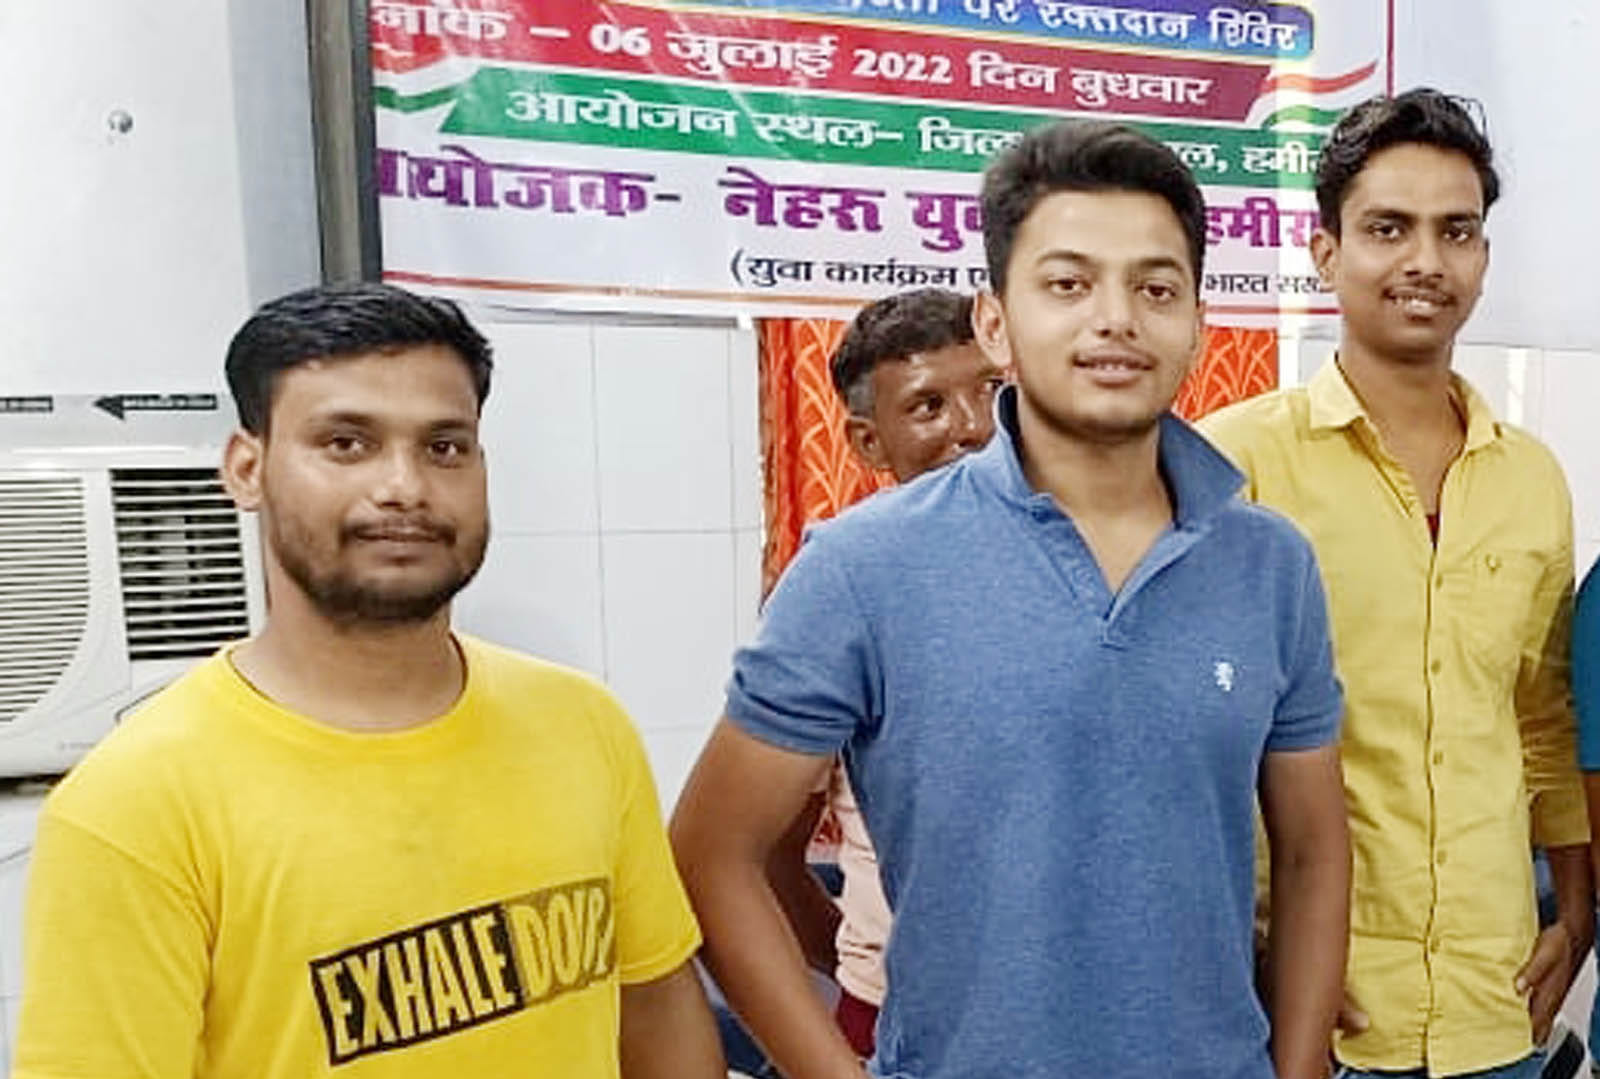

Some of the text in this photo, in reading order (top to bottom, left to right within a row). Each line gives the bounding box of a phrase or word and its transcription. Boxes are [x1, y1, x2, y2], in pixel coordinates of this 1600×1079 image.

[589, 23, 652, 56] 06
[664, 32, 839, 78] जुलाई
[852, 48, 953, 84] 2022
[966, 50, 1061, 94] दिन
[1070, 66, 1213, 107] बुधवार
[505, 88, 739, 138] आयोजन
[318, 910, 516, 1057] EXHALE
